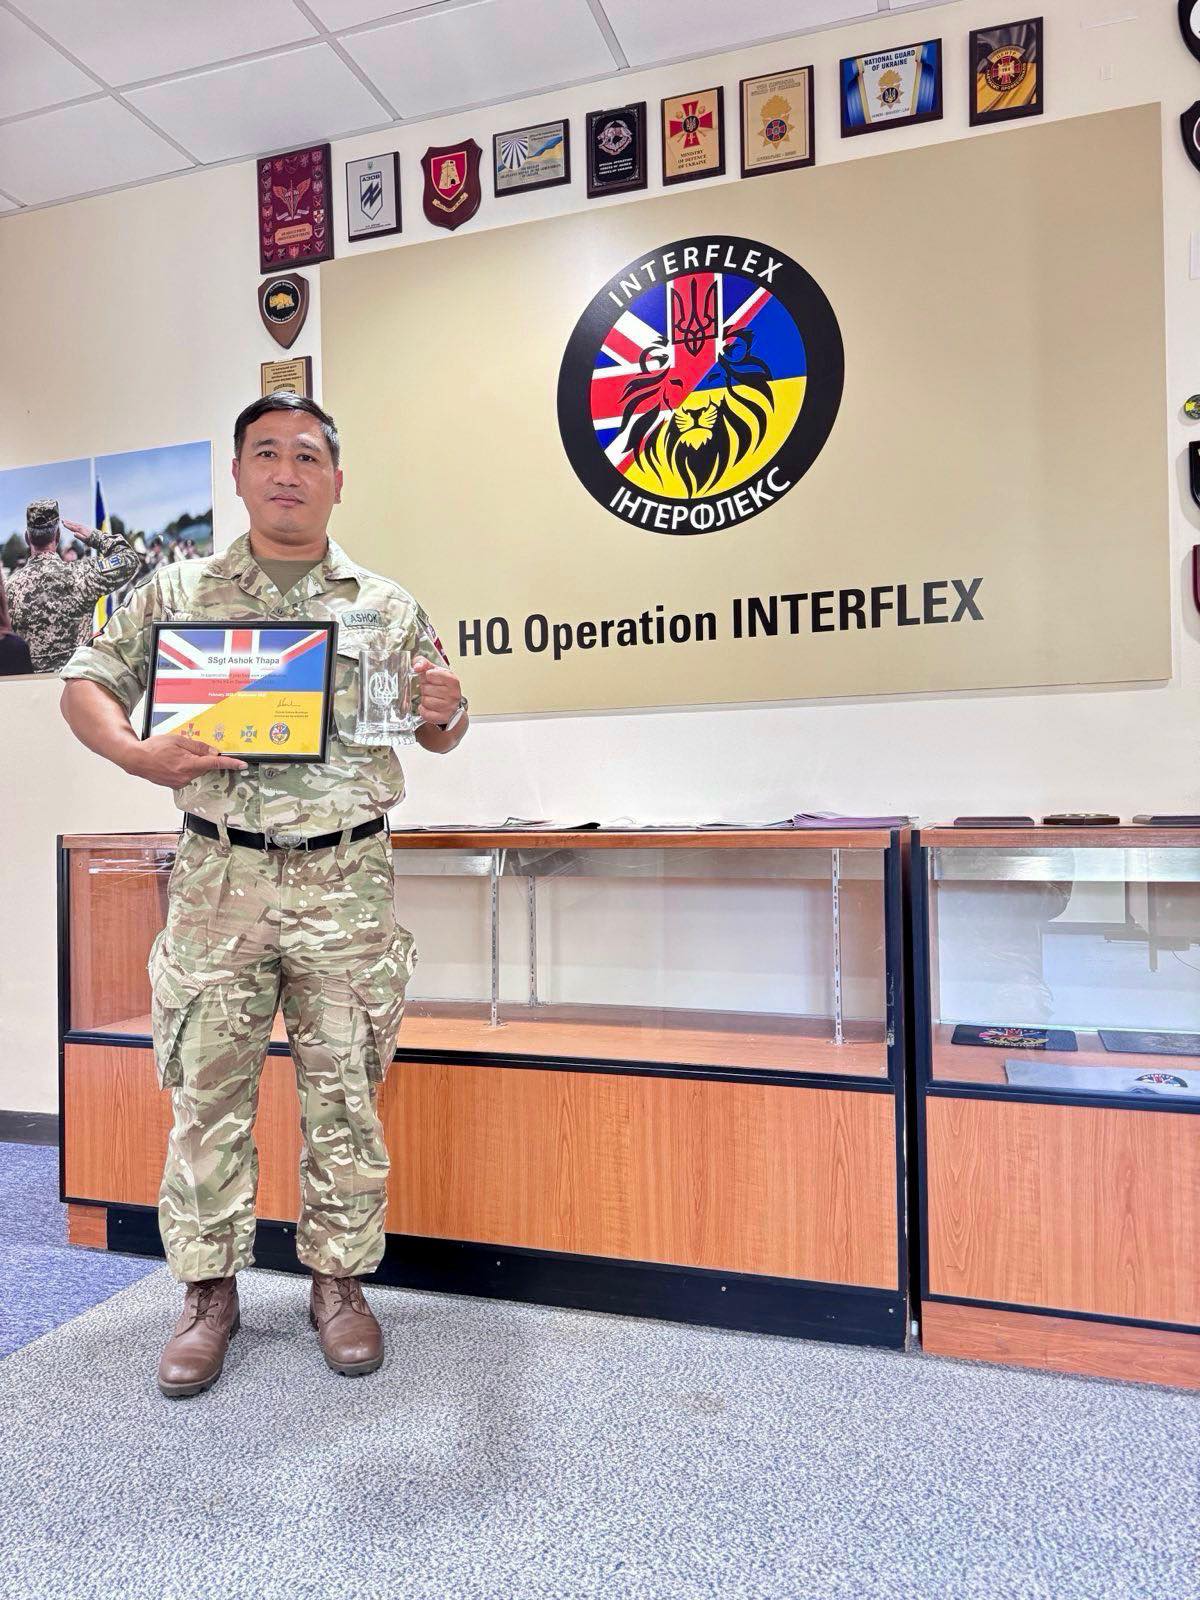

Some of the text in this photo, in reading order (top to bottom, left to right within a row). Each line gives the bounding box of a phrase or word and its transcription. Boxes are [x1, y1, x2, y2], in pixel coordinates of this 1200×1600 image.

[863, 49, 916, 67] NATIONAL GUARD
[881, 58, 908, 69] UKRAINE
[680, 149, 704, 157] MINISTRY
[685, 159, 706, 168] UKRAINE
[608, 244, 783, 307] INTERFLEX
[609, 466, 791, 530] ІНТЕРФЛЕКС
[350, 612, 378, 624] ASHOK
[458, 577, 984, 661] HQ Operation INTERFLEX
[207, 656, 280, 666] SSgt Ashok Thapa
